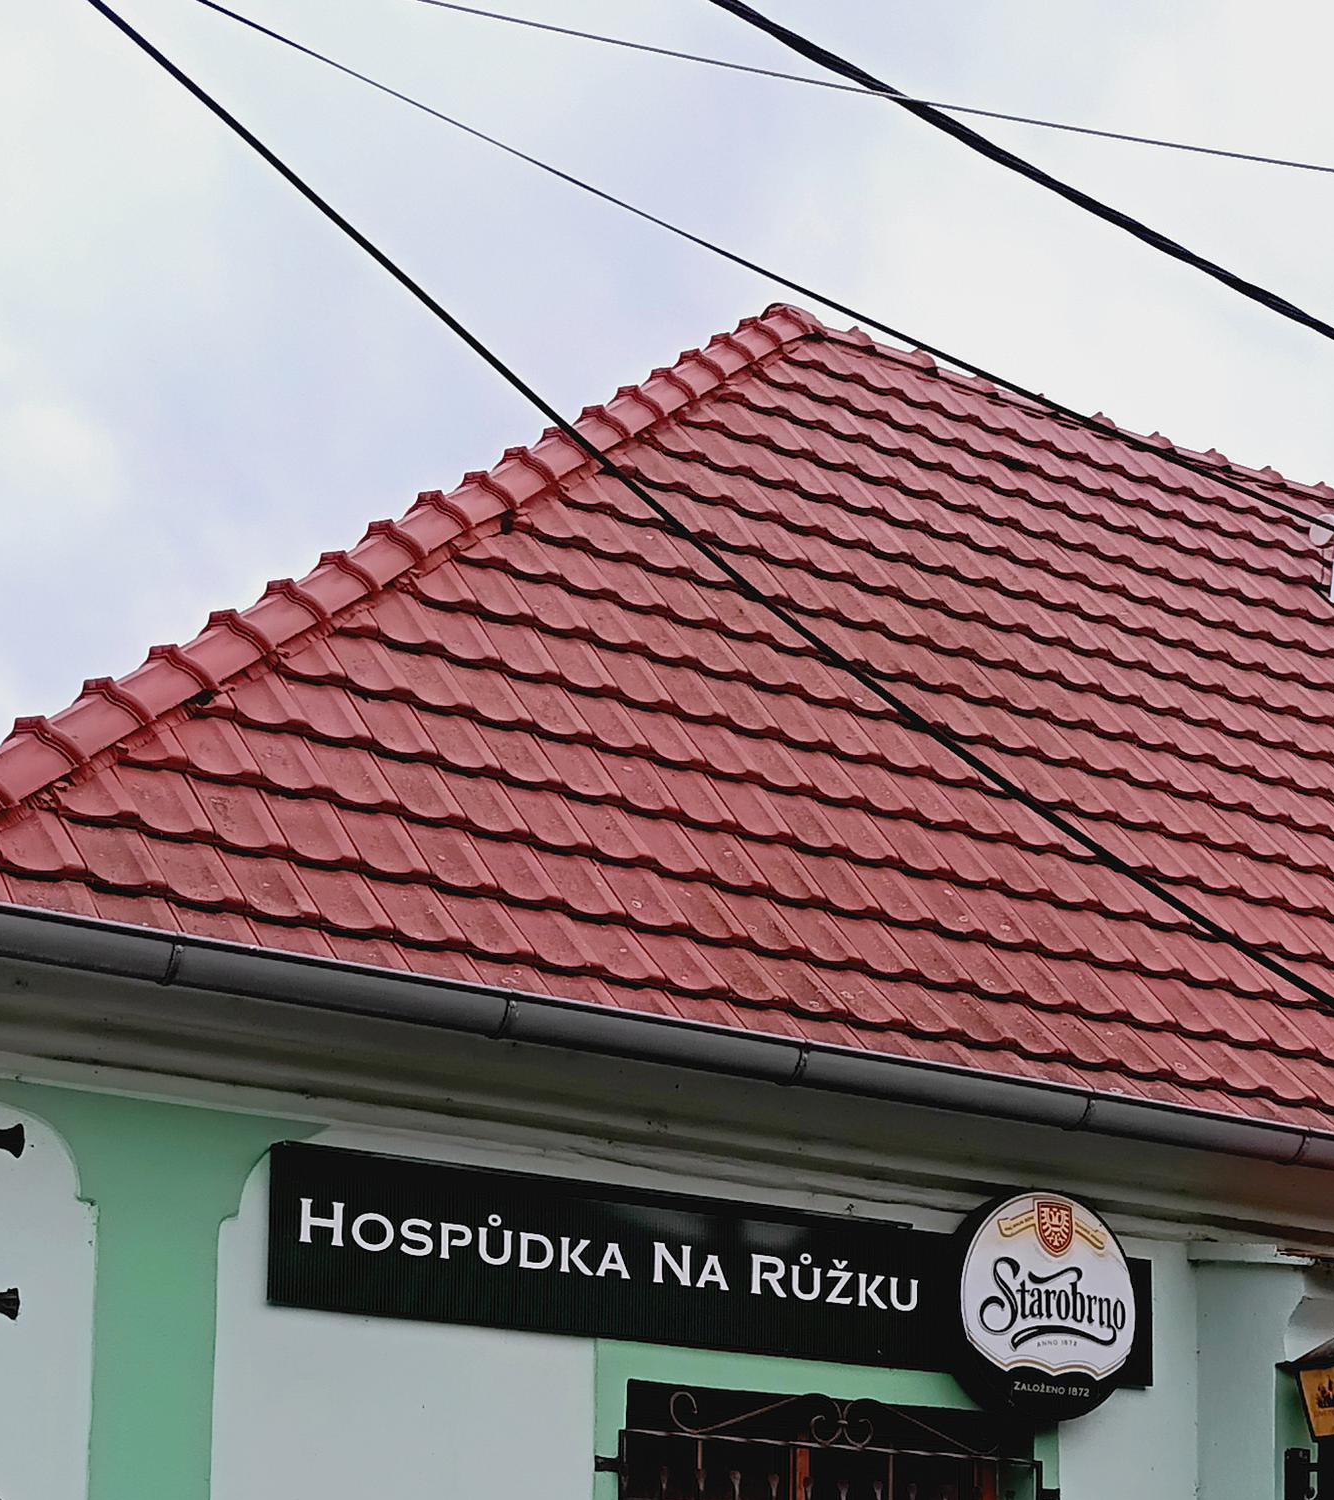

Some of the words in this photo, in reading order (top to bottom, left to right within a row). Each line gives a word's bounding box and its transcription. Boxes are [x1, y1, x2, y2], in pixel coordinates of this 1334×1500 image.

[979, 1256, 1126, 1350] Starobrno
[1013, 1380, 1066, 1396] ZALOŽENO
[1068, 1386, 1090, 1398] 1872
